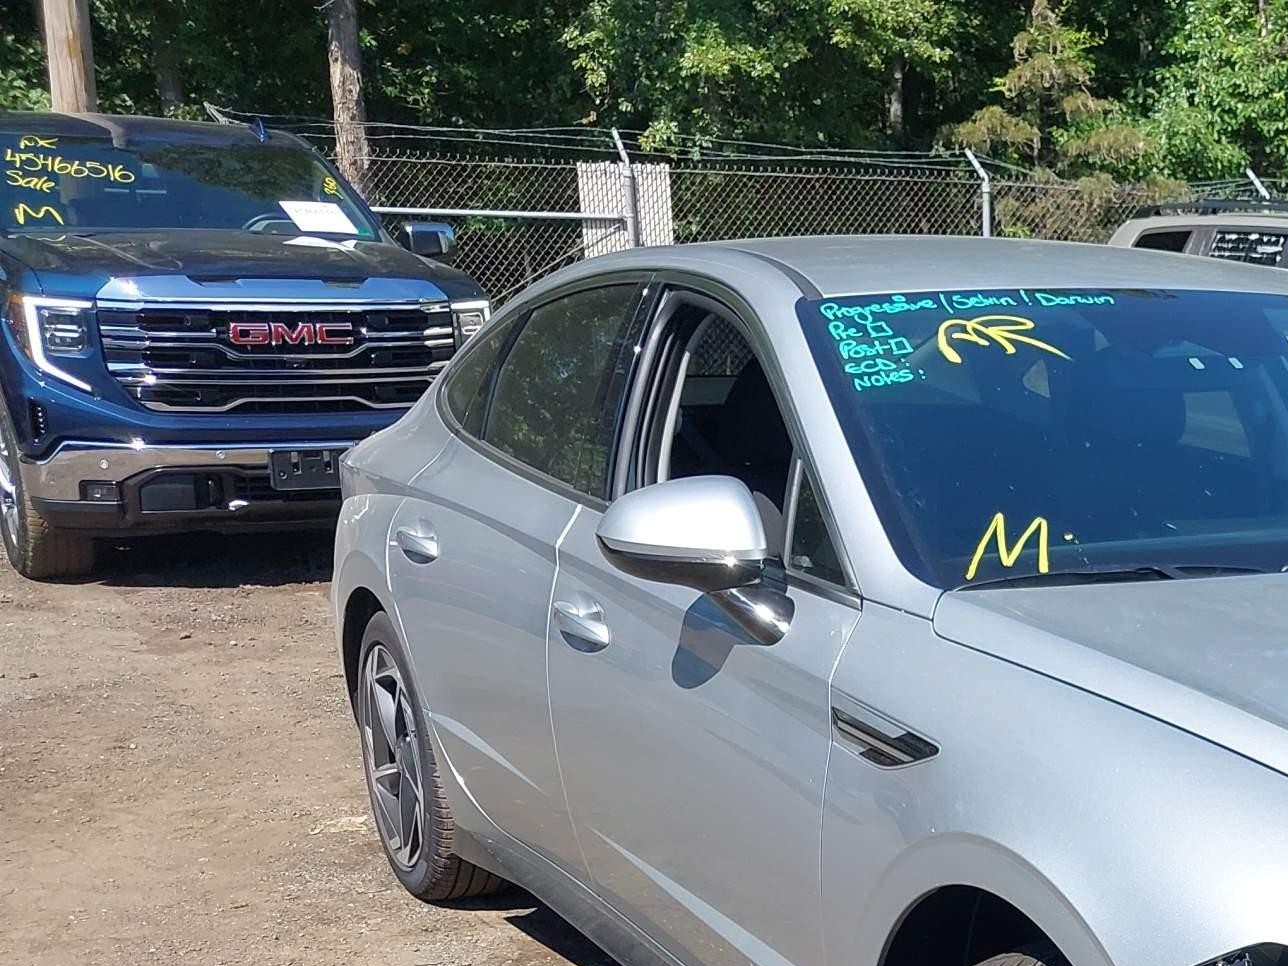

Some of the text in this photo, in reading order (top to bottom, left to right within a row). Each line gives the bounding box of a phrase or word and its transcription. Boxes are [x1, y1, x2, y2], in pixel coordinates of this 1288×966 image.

[5, 148, 136, 183] 45466516
[5, 169, 56, 193] Sale
[14, 202, 65, 226] M
[819, 295, 938, 325] Progressive
[228, 322, 355, 345] GMC
